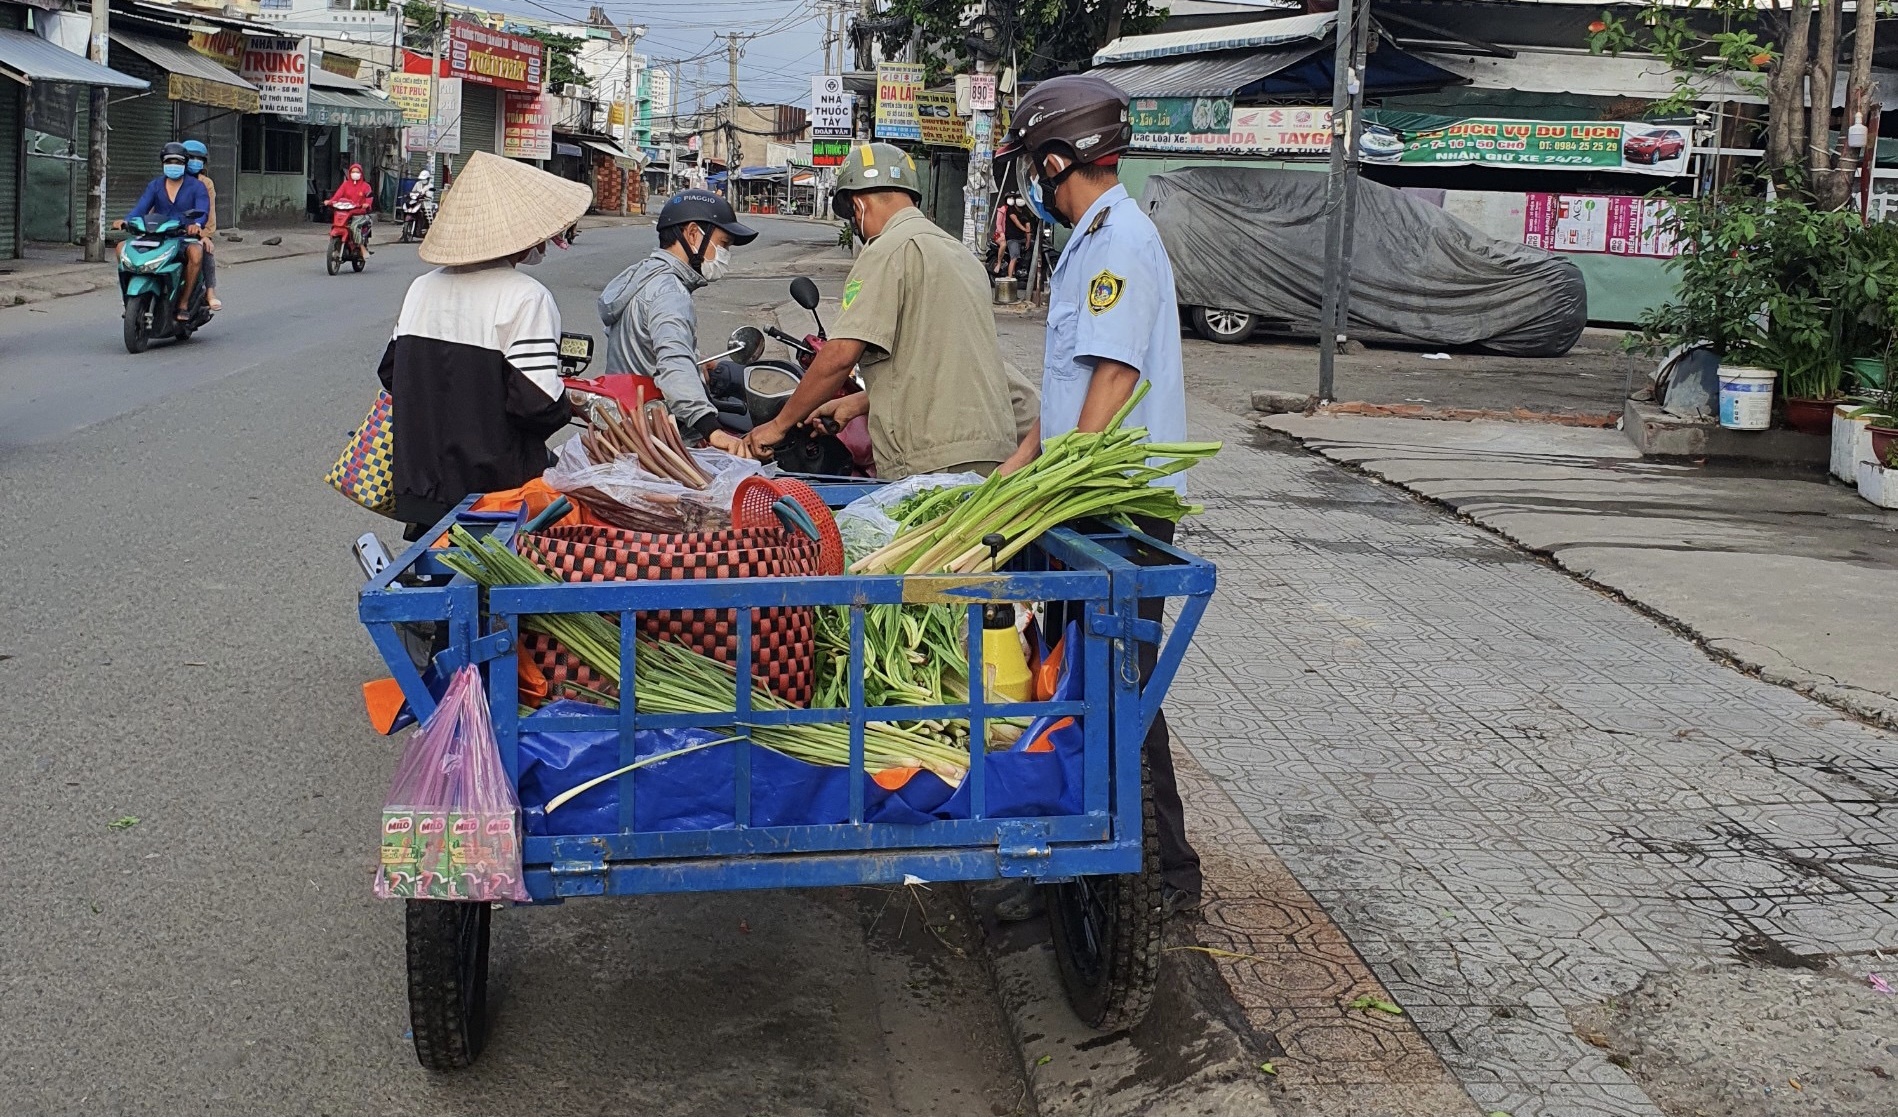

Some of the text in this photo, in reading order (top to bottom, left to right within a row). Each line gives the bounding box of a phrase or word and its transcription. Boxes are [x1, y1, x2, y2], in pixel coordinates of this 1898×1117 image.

[244, 51, 305, 74] TRUNG
[265, 74, 304, 84] VESTON
[821, 93, 842, 103] NHÀ
[880, 85, 896, 100] GIA
[972, 85, 987, 100] 890
[815, 104, 849, 115] THUỐC
[822, 116, 840, 126] TÂY
[1448, 124, 1497, 138] DỊCH
[1503, 125, 1531, 140] VỤ
[1536, 126, 1566, 138] DU
[1572, 126, 1621, 141] LỊCH
[1174, 135, 1188, 144] Xe:
[1190, 132, 1257, 145] HONDA
[1449, 140, 1465, 149] 16
[1554, 142, 1577, 150] 0984
[1578, 142, 1591, 151] 25
[1592, 142, 1604, 151] 25
[1606, 143, 1618, 152] 29
[1435, 150, 1594, 164] NHẬN GIỮ XE 24/24
[683, 195, 715, 204] PIAGGIO
[1573, 199, 1582, 221] ACS
[1629, 199, 1638, 216] TIỀN
[1569, 229, 1577, 244] FE
[388, 820, 410, 831] MILO
[422, 821, 443, 832] MILO
[455, 822, 478, 832] MILO
[488, 822, 510, 832] MILO
